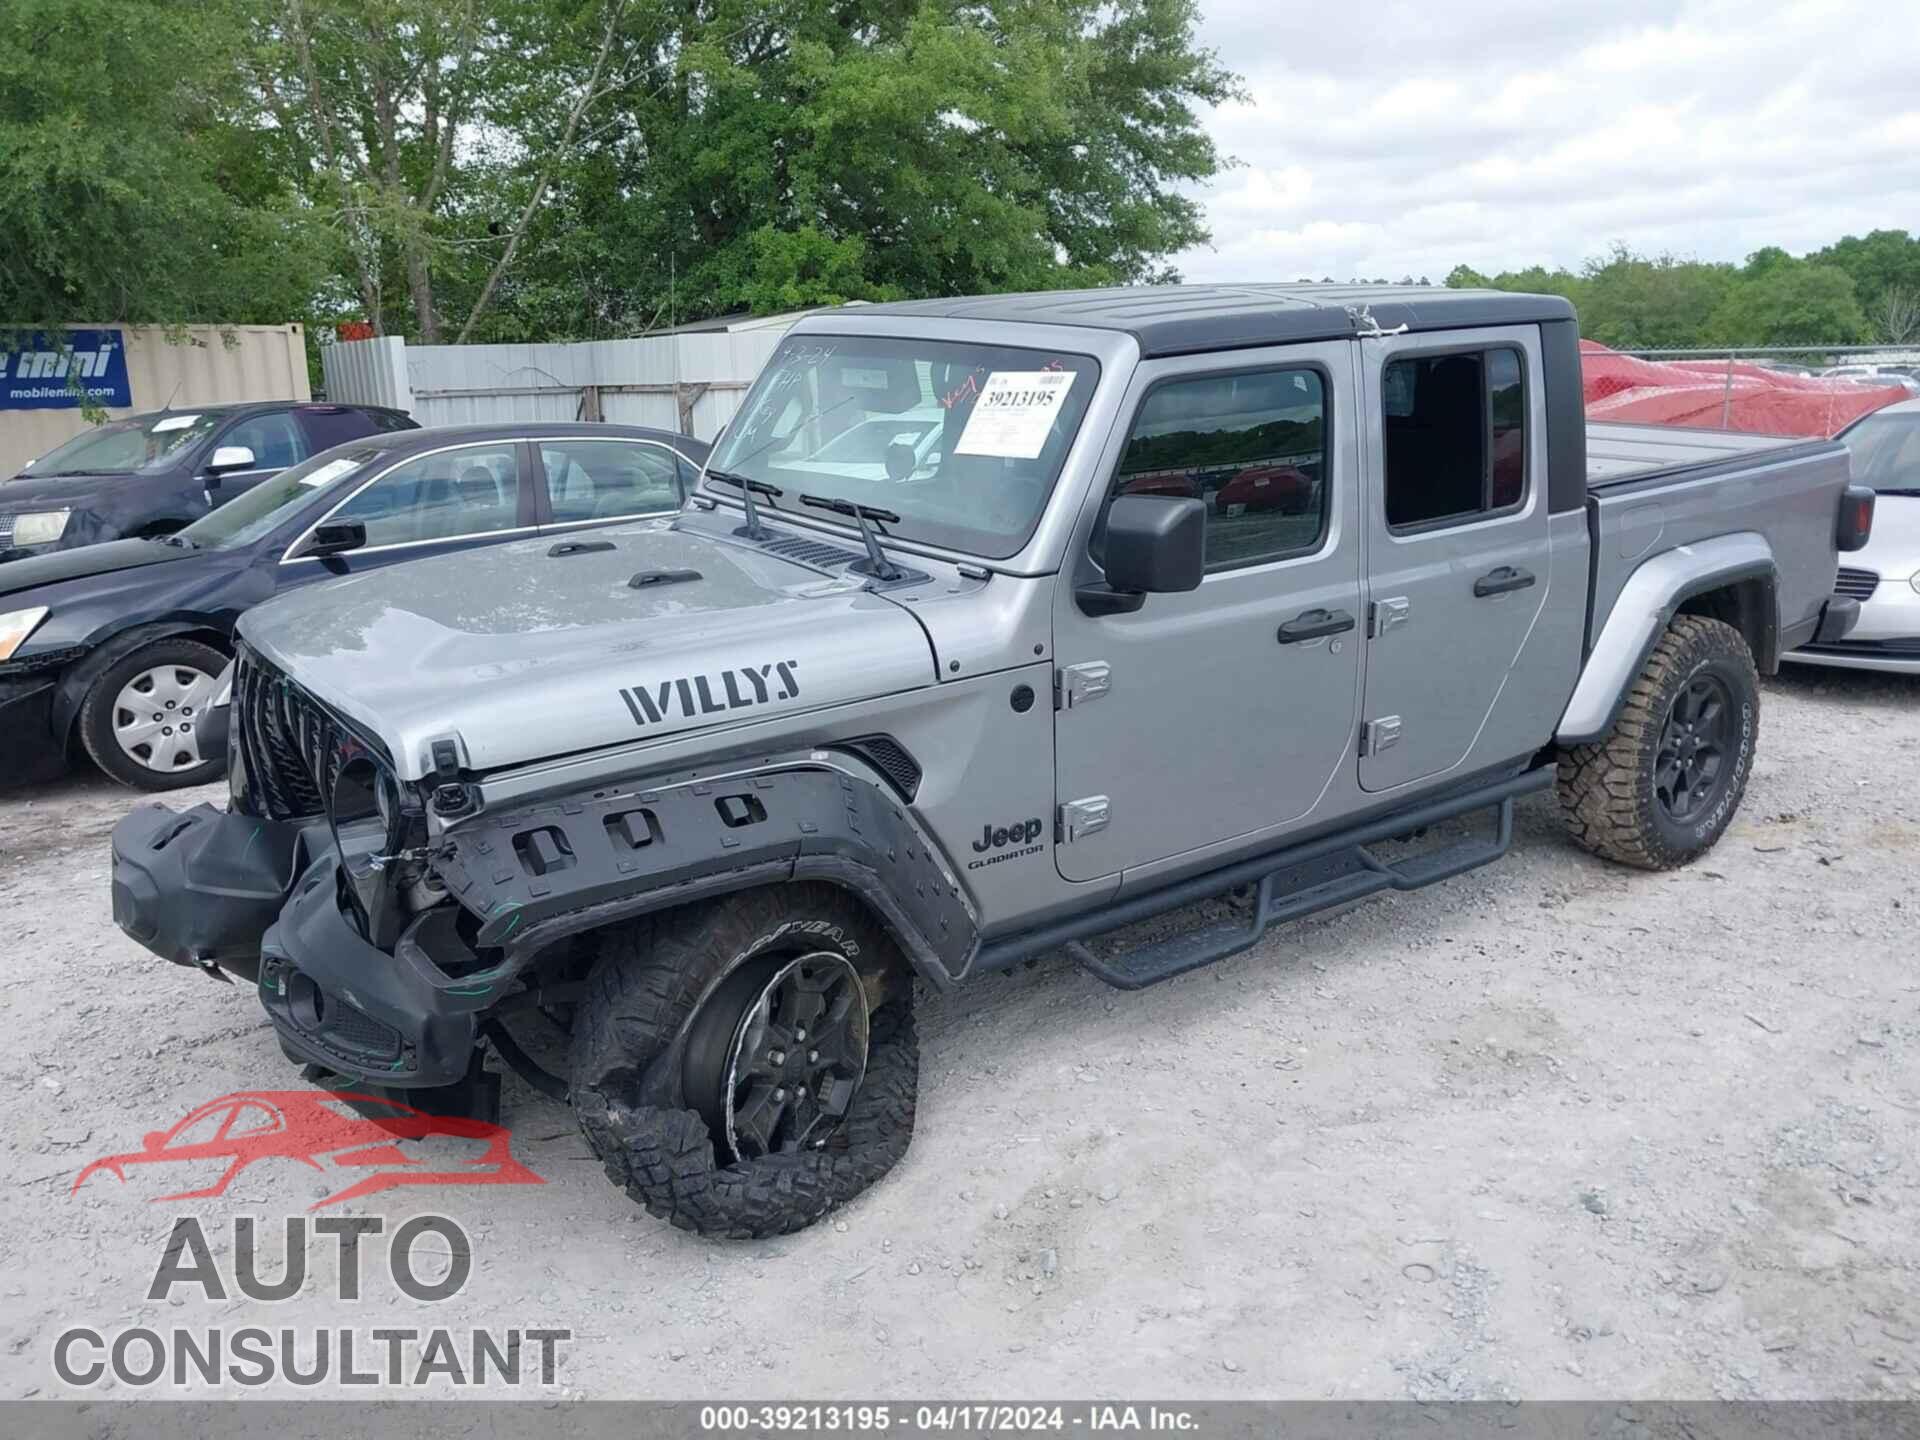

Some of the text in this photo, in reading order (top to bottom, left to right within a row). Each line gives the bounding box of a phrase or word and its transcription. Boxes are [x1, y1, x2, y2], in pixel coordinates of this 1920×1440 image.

[15, 344, 112, 379] mini
[10, 386, 115, 399] mobileminicom
[984, 390, 1057, 408] 39213195
[618, 660, 800, 726] WILLYS
[972, 817, 1043, 853] Jeep
[967, 844, 1044, 870] GLADIATOR
